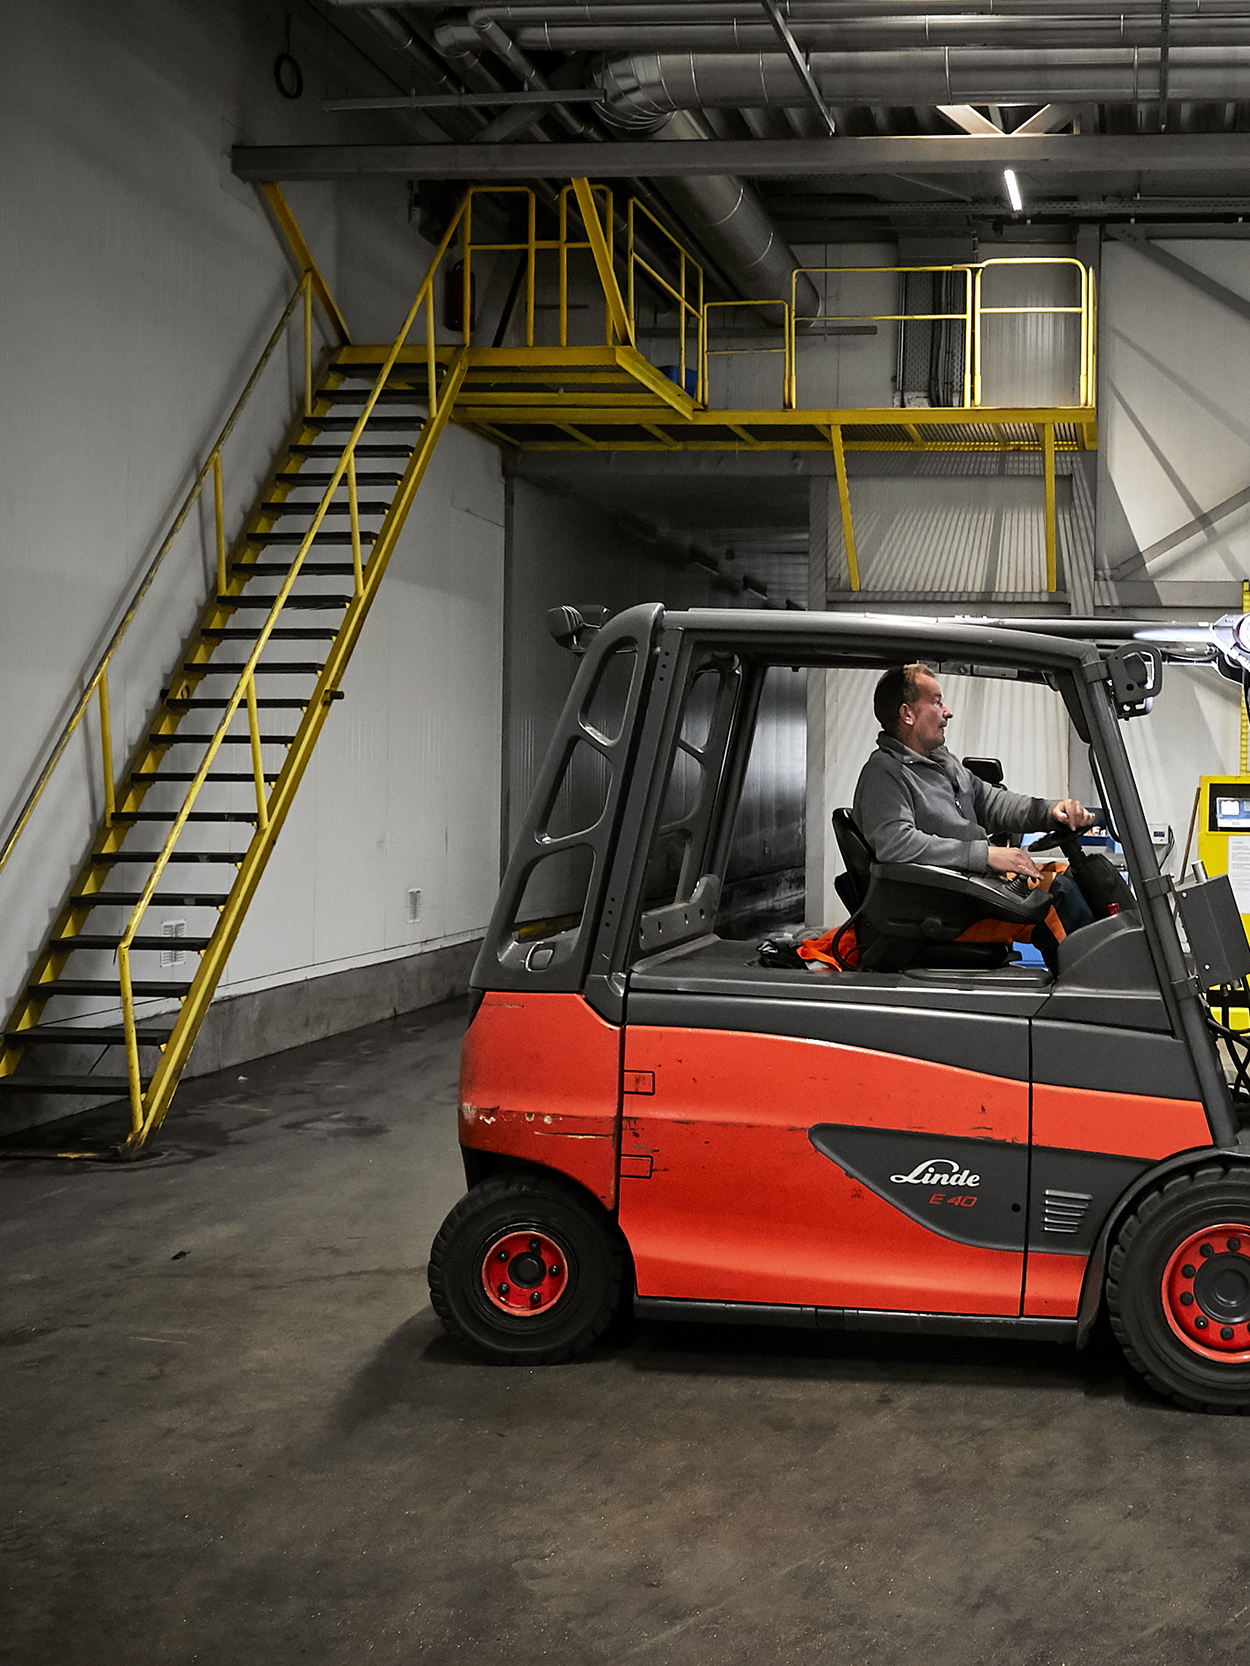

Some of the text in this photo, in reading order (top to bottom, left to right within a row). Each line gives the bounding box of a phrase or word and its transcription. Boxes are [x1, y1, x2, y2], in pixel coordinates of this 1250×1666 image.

[889, 1159, 980, 1187] Linde
[928, 1193, 978, 1208] E 40
